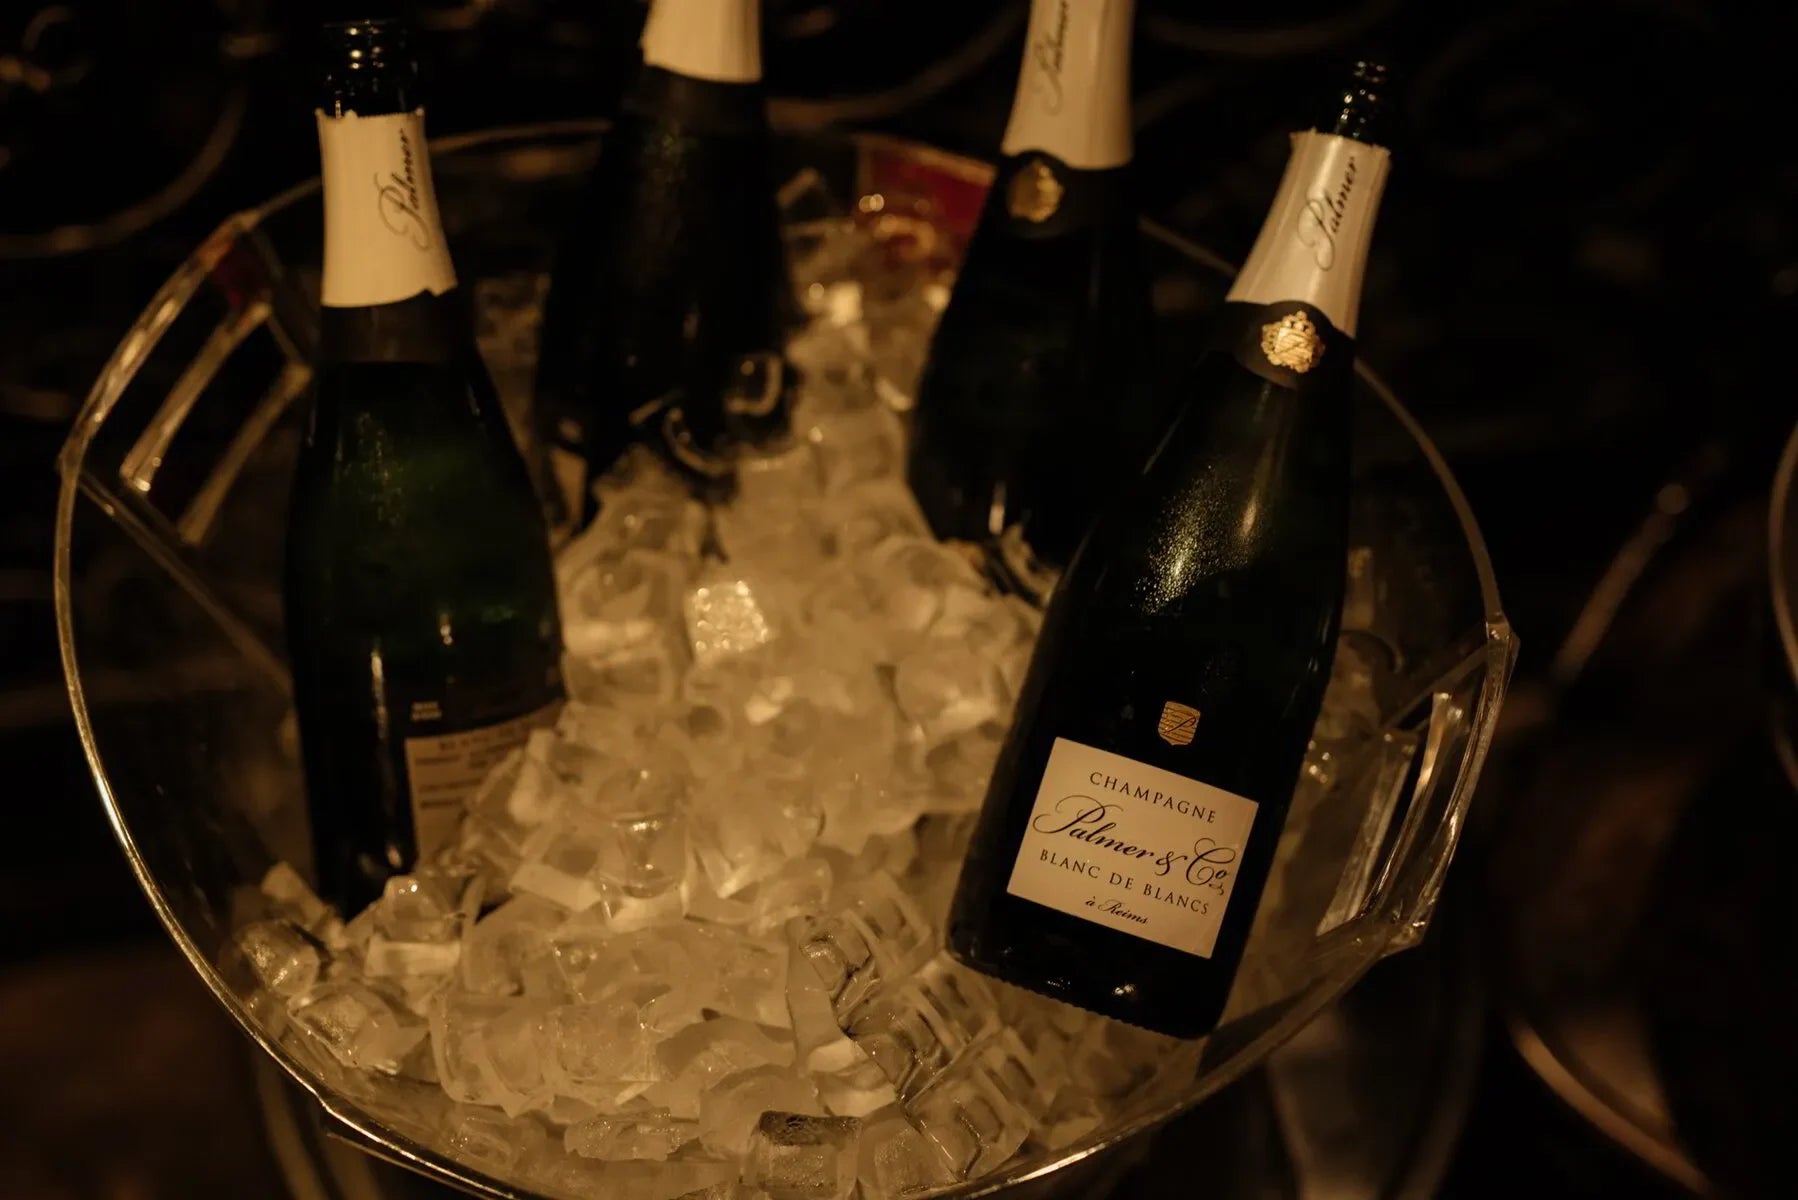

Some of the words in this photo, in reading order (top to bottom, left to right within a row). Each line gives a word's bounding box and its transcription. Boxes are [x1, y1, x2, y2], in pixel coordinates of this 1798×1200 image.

[374, 127, 431, 252] Palmer
[1298, 156, 1357, 272] Palmer
[1089, 771, 1217, 824] CHAMPAGNE
[1032, 794, 1155, 860] Palmer
[1154, 850, 1188, 877] &
[1039, 849, 1101, 879] BLANC
[1108, 872, 1134, 890] DE
[1142, 883, 1210, 916] BLANCS
[1084, 896, 1097, 908] à
[1097, 898, 1149, 925] Reims
